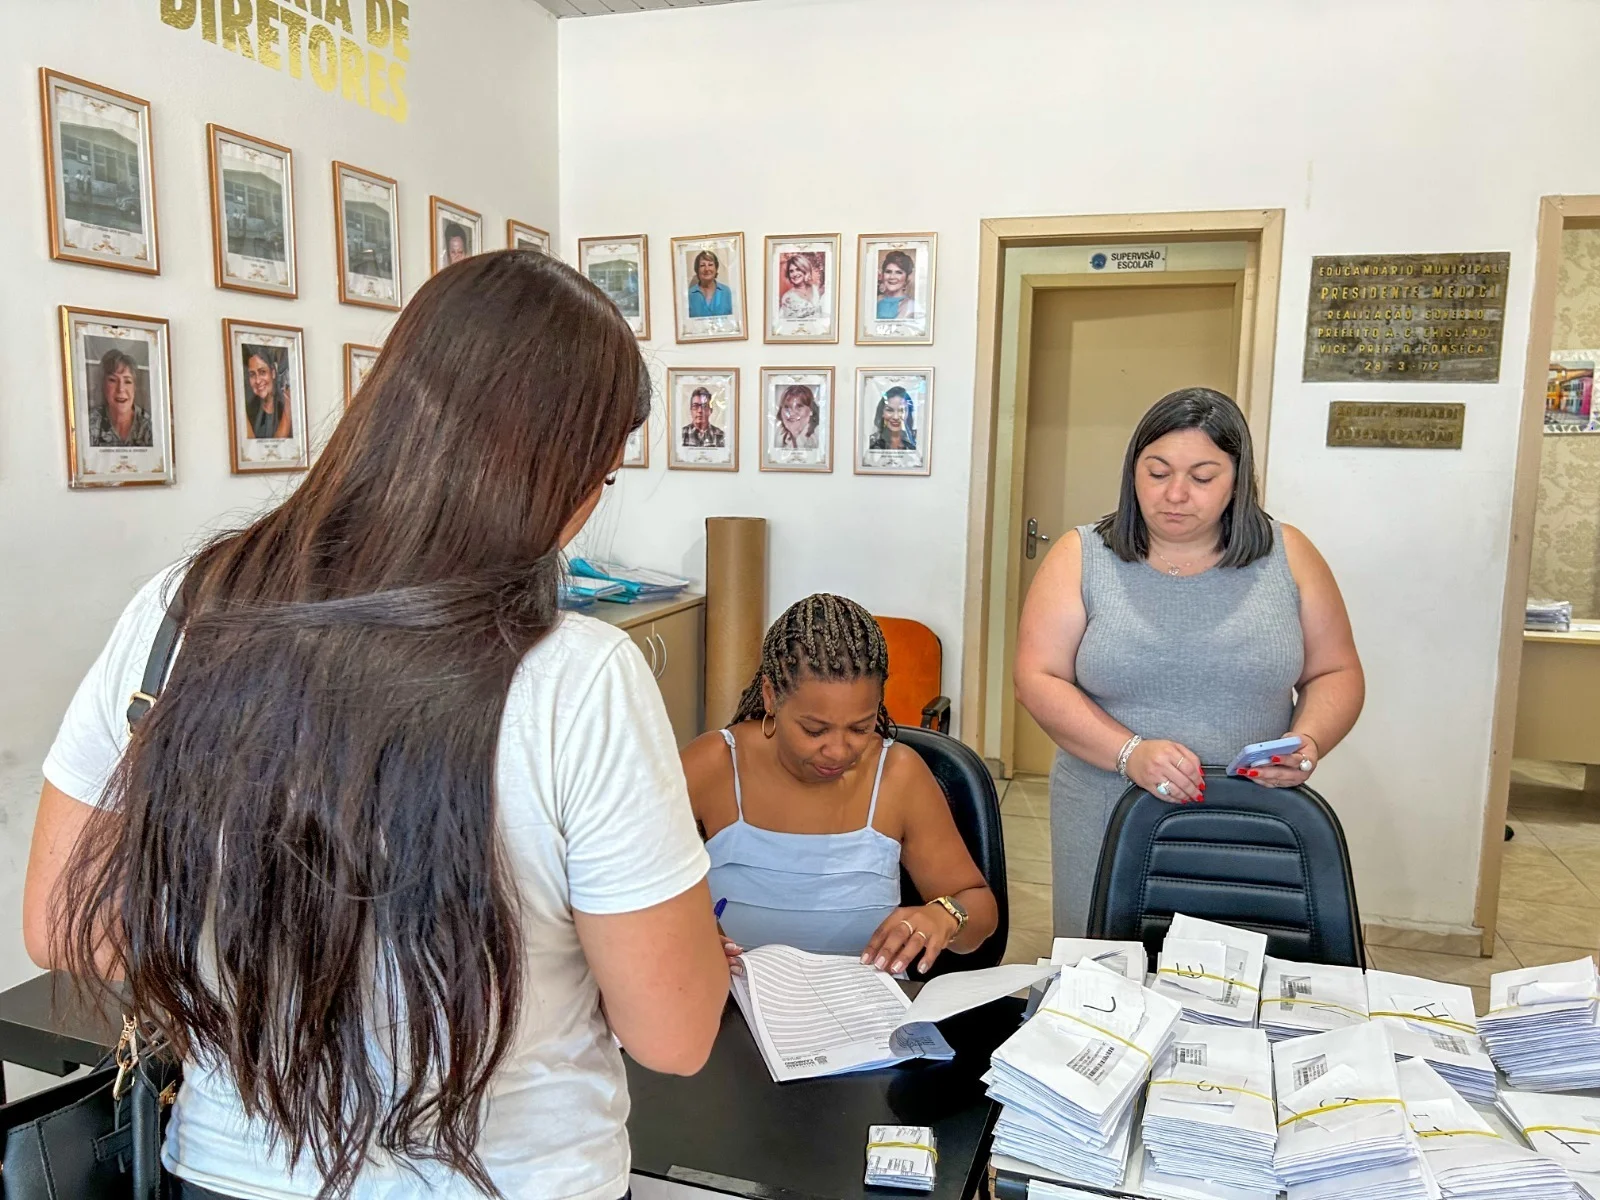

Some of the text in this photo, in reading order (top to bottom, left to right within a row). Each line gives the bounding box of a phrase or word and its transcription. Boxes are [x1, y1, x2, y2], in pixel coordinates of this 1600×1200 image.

[366, 0, 409, 62] DE
[1111, 250, 1160, 261] SUPERVISÃO
[1117, 260, 1154, 270] ESCOLAR
[1422, 264, 1500, 275] MUNICIPAL
[1321, 286, 1420, 300] PRESIDENTE
[1425, 308, 1485, 320] GOVERNO
[1317, 327, 1380, 339] PREFEITO
[1320, 344, 1348, 354] VICE
[1422, 344, 1484, 354] FONSECA
